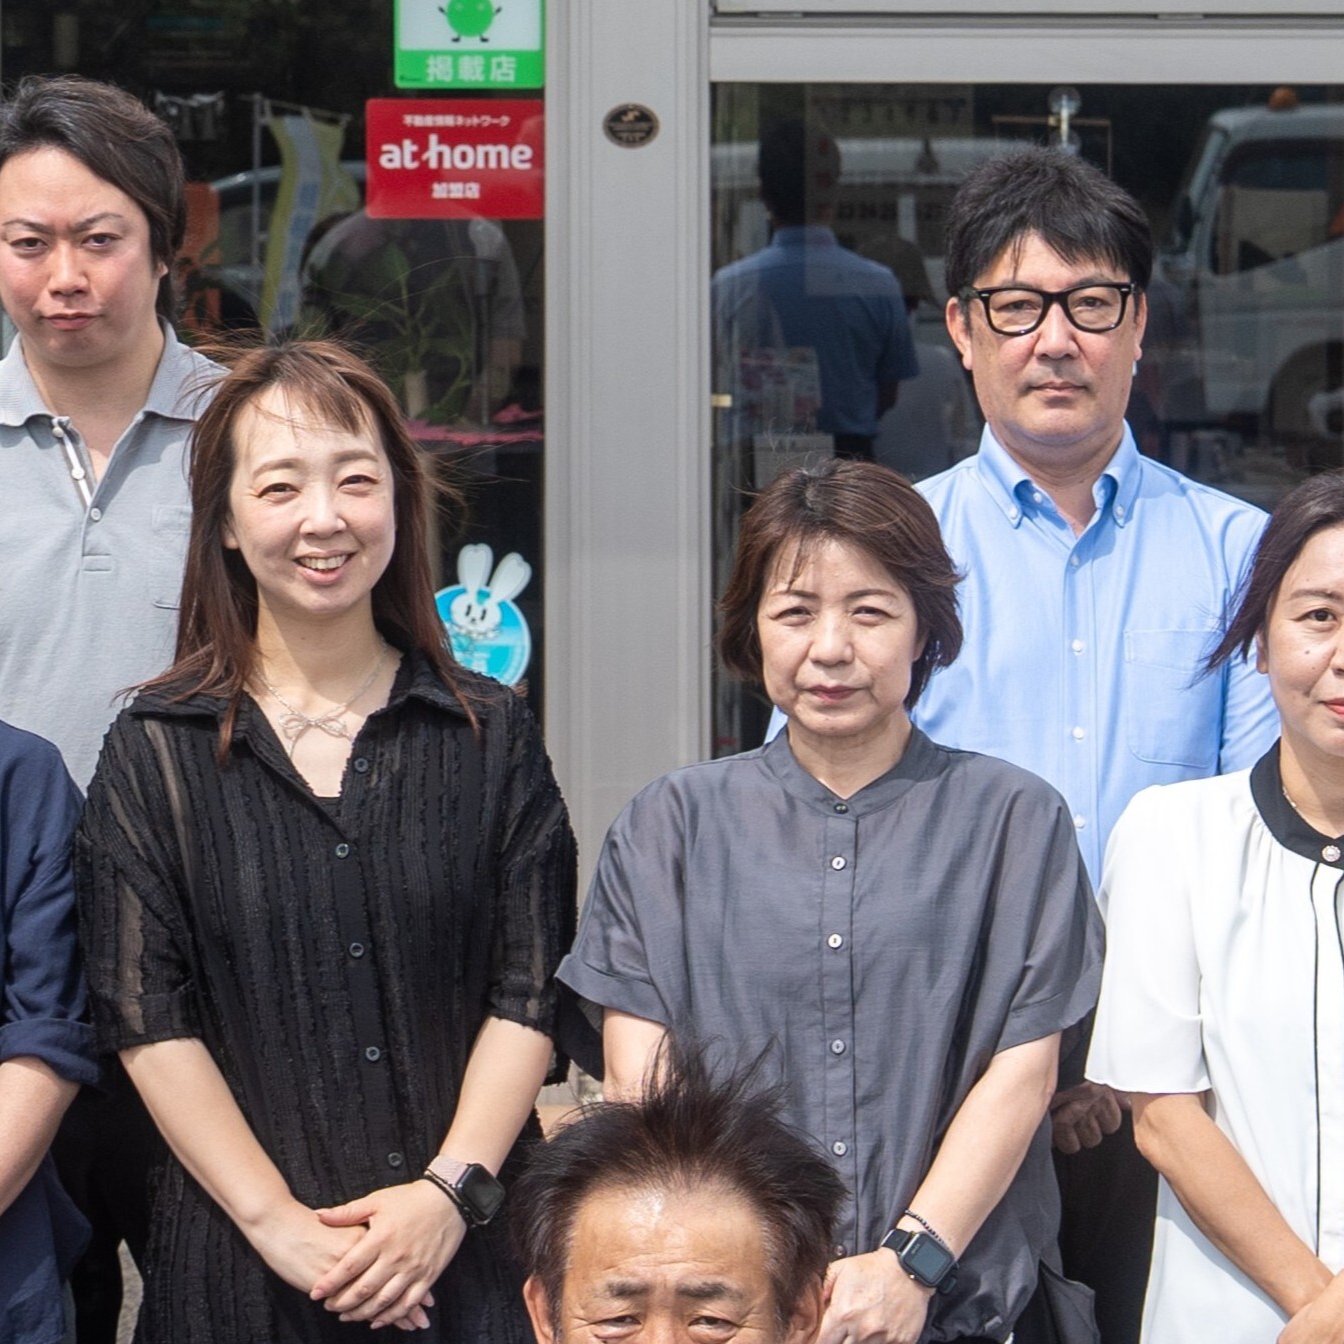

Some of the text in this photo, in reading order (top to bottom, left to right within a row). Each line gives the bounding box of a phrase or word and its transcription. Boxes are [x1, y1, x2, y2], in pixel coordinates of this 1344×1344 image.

[426, 55, 517, 82] 掲載店
[379, 133, 533, 170] at home
